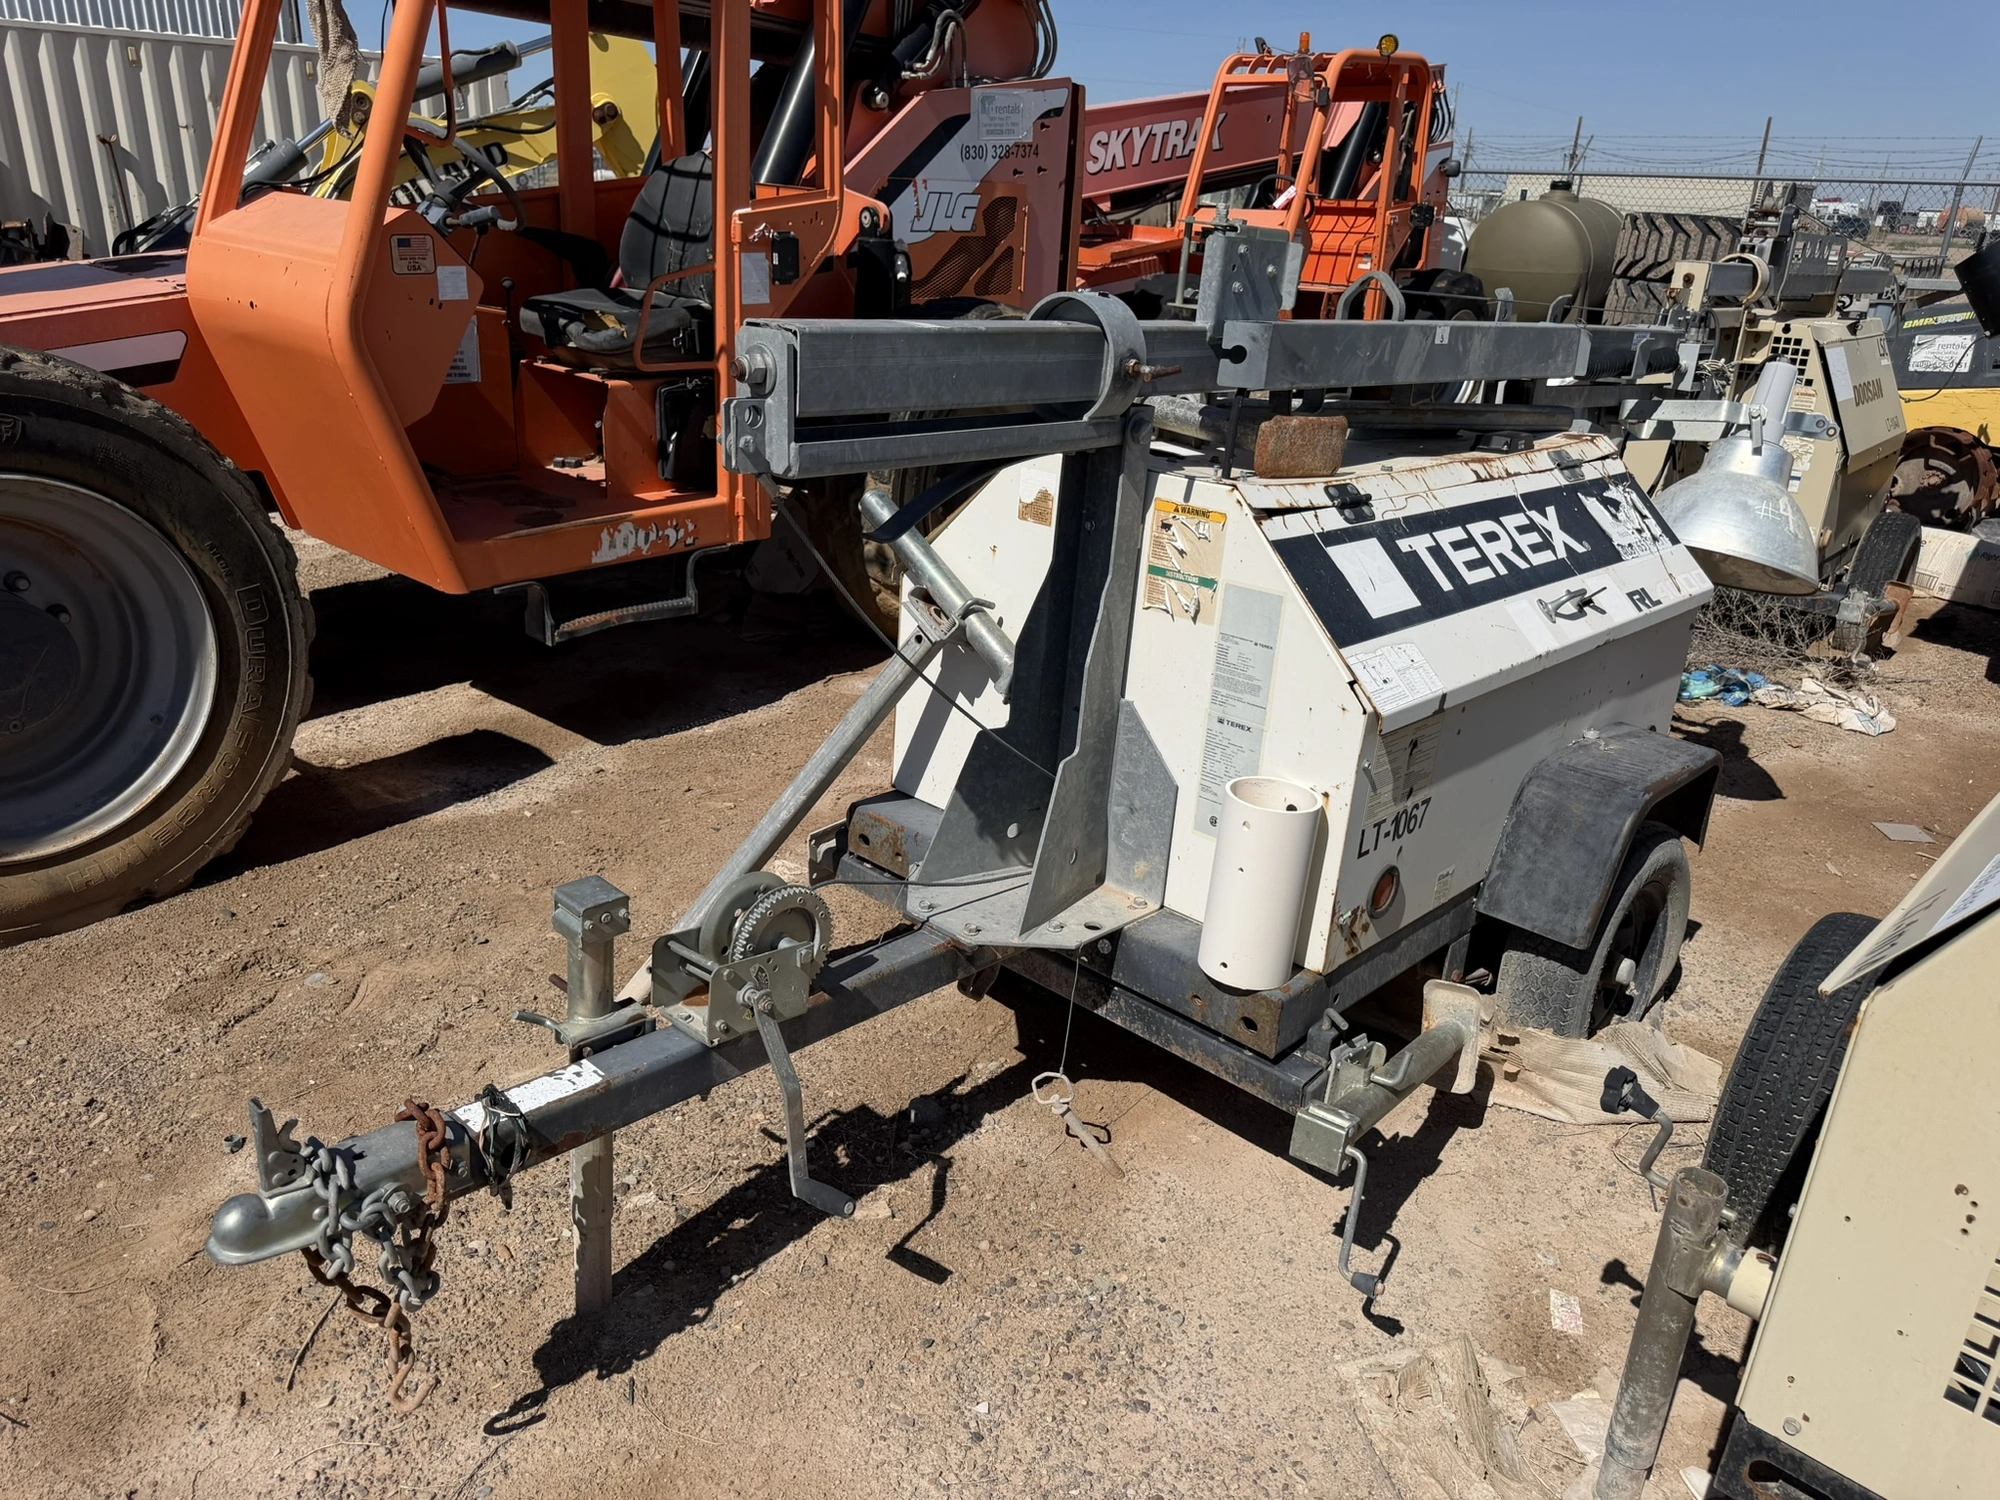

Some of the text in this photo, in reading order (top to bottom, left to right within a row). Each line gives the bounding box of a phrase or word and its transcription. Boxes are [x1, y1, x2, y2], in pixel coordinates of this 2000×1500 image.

[995, 102, 1020, 114] rentals
[960, 143, 1039, 162] (830) 328-7374
[910, 191, 982, 233] JLG
[1937, 342, 1967, 350] rentals
[1853, 378, 1884, 407] DOOSAN
[1180, 506, 1211, 519] WARNING
[1395, 505, 1589, 592] TEREX
[1165, 570, 1199, 584] INSTRUCTIONS
[1226, 719, 1252, 733] TEREX
[1357, 797, 1432, 860] LT-1067
